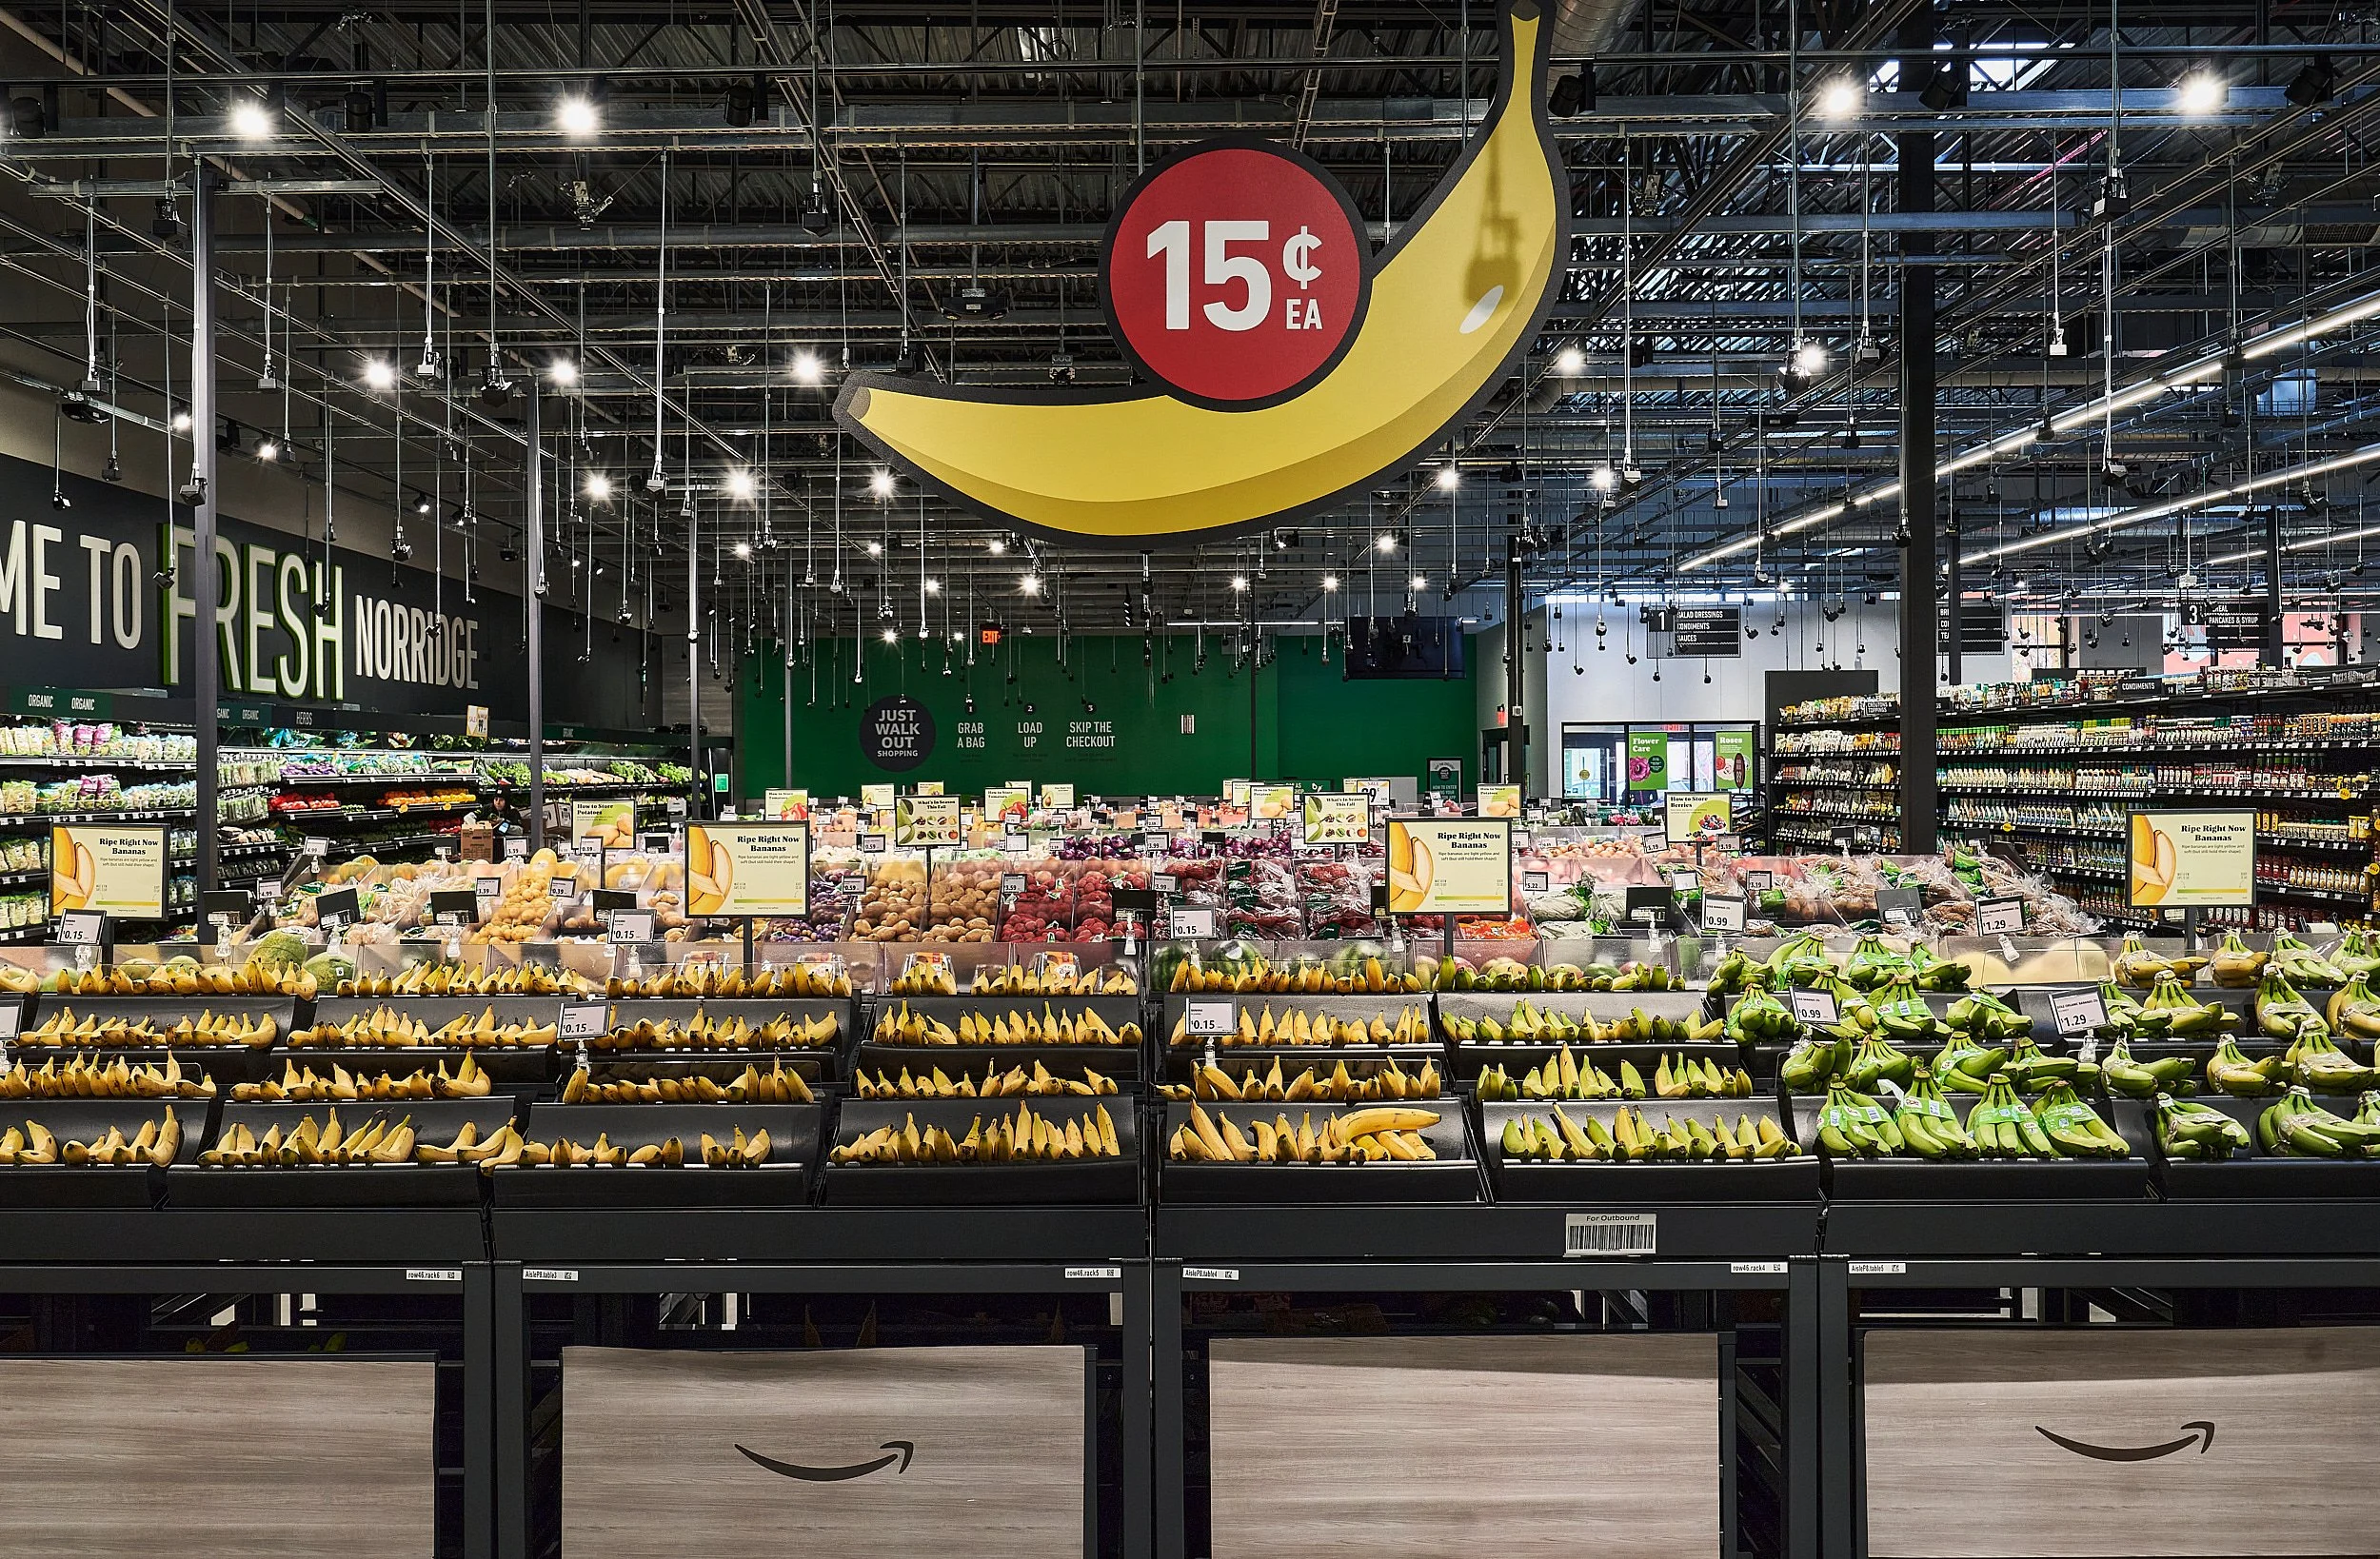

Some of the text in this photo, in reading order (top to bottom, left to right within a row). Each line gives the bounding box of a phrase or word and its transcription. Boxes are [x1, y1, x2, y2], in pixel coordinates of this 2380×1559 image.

[1286, 299, 1322, 329] EA
[80, 534, 142, 650] TO
[163, 523, 344, 701] FRESH
[355, 594, 479, 690] NORRIDGE
[2190, 605, 2197, 623] 3
[1658, 611, 1664, 630] 1
[982, 630, 999, 642] EXIT
[29, 694, 53, 708] ORGANIC
[71, 697, 94, 710] ORGANIC
[242, 709, 259, 720] ORGANIC
[296, 712, 312, 725] HERBS
[879, 710, 916, 721] JUST
[875, 723, 920, 735] WALK
[958, 722, 984, 734] GRAB
[1018, 721, 1042, 734] LOAD
[1070, 721, 1112, 733] SKIP THE
[882, 737, 914, 748] OUT
[958, 737, 985, 748] A BAG
[1024, 737, 1037, 748] UP
[1066, 736, 1116, 747] CHECKOUT
[737, 836, 756, 844] Ripe
[1438, 832, 1457, 840] Ripe
[1458, 832, 1481, 840] Right
[120, 839, 140, 847] Right
